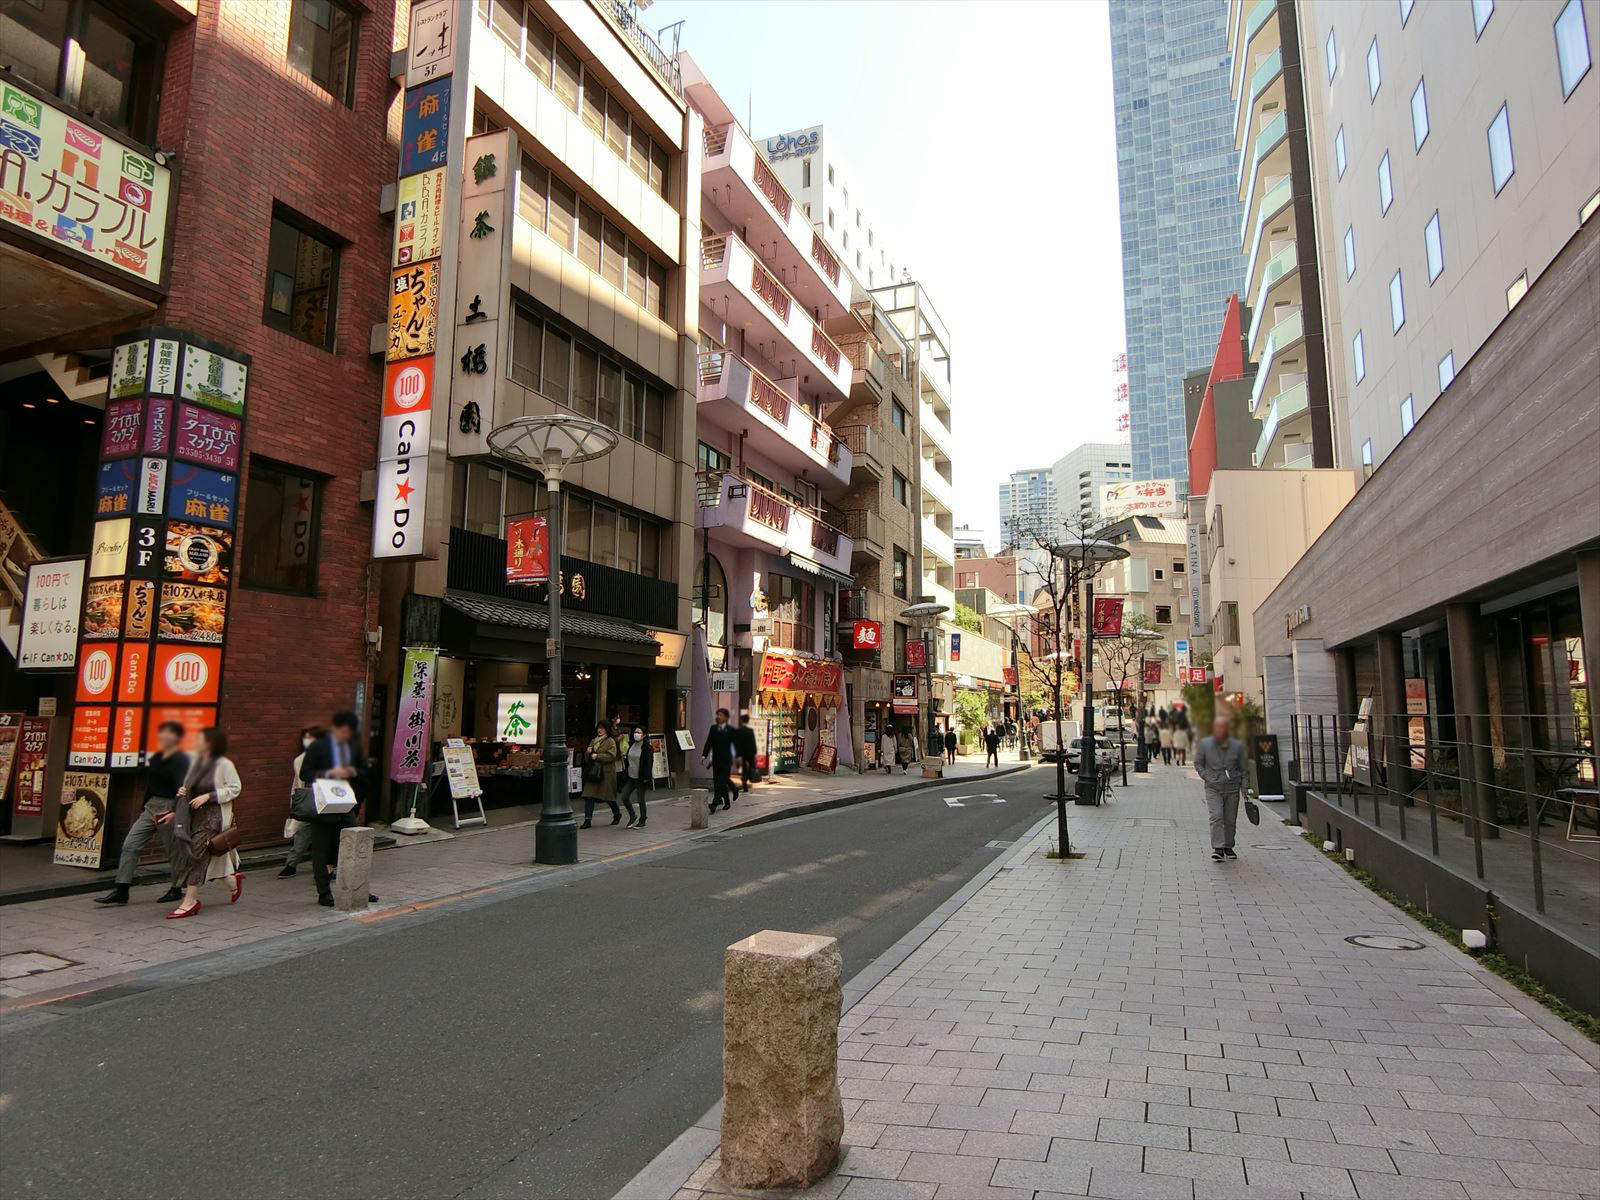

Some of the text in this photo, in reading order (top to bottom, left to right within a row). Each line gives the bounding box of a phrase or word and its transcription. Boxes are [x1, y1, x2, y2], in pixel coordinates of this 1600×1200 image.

[424, 63, 437, 77] 5F
[417, 93, 440, 154] 麻雀
[432, 151, 447, 163] 4F
[406, 268, 427, 353] ちゃんこ
[400, 374, 419, 397] 100
[220, 474, 233, 483] 4F
[184, 498, 231, 523] 麻雀
[1190, 528, 1198, 575] PLATINA
[36, 572, 71, 588] 100円で
[132, 585, 148, 630] ちゃんこ
[857, 626, 876, 645] 麺
[89, 659, 107, 681] 100
[174, 660, 201, 682] 100
[1192, 669, 1204, 681] 足
[504, 699, 531, 738] 茶
